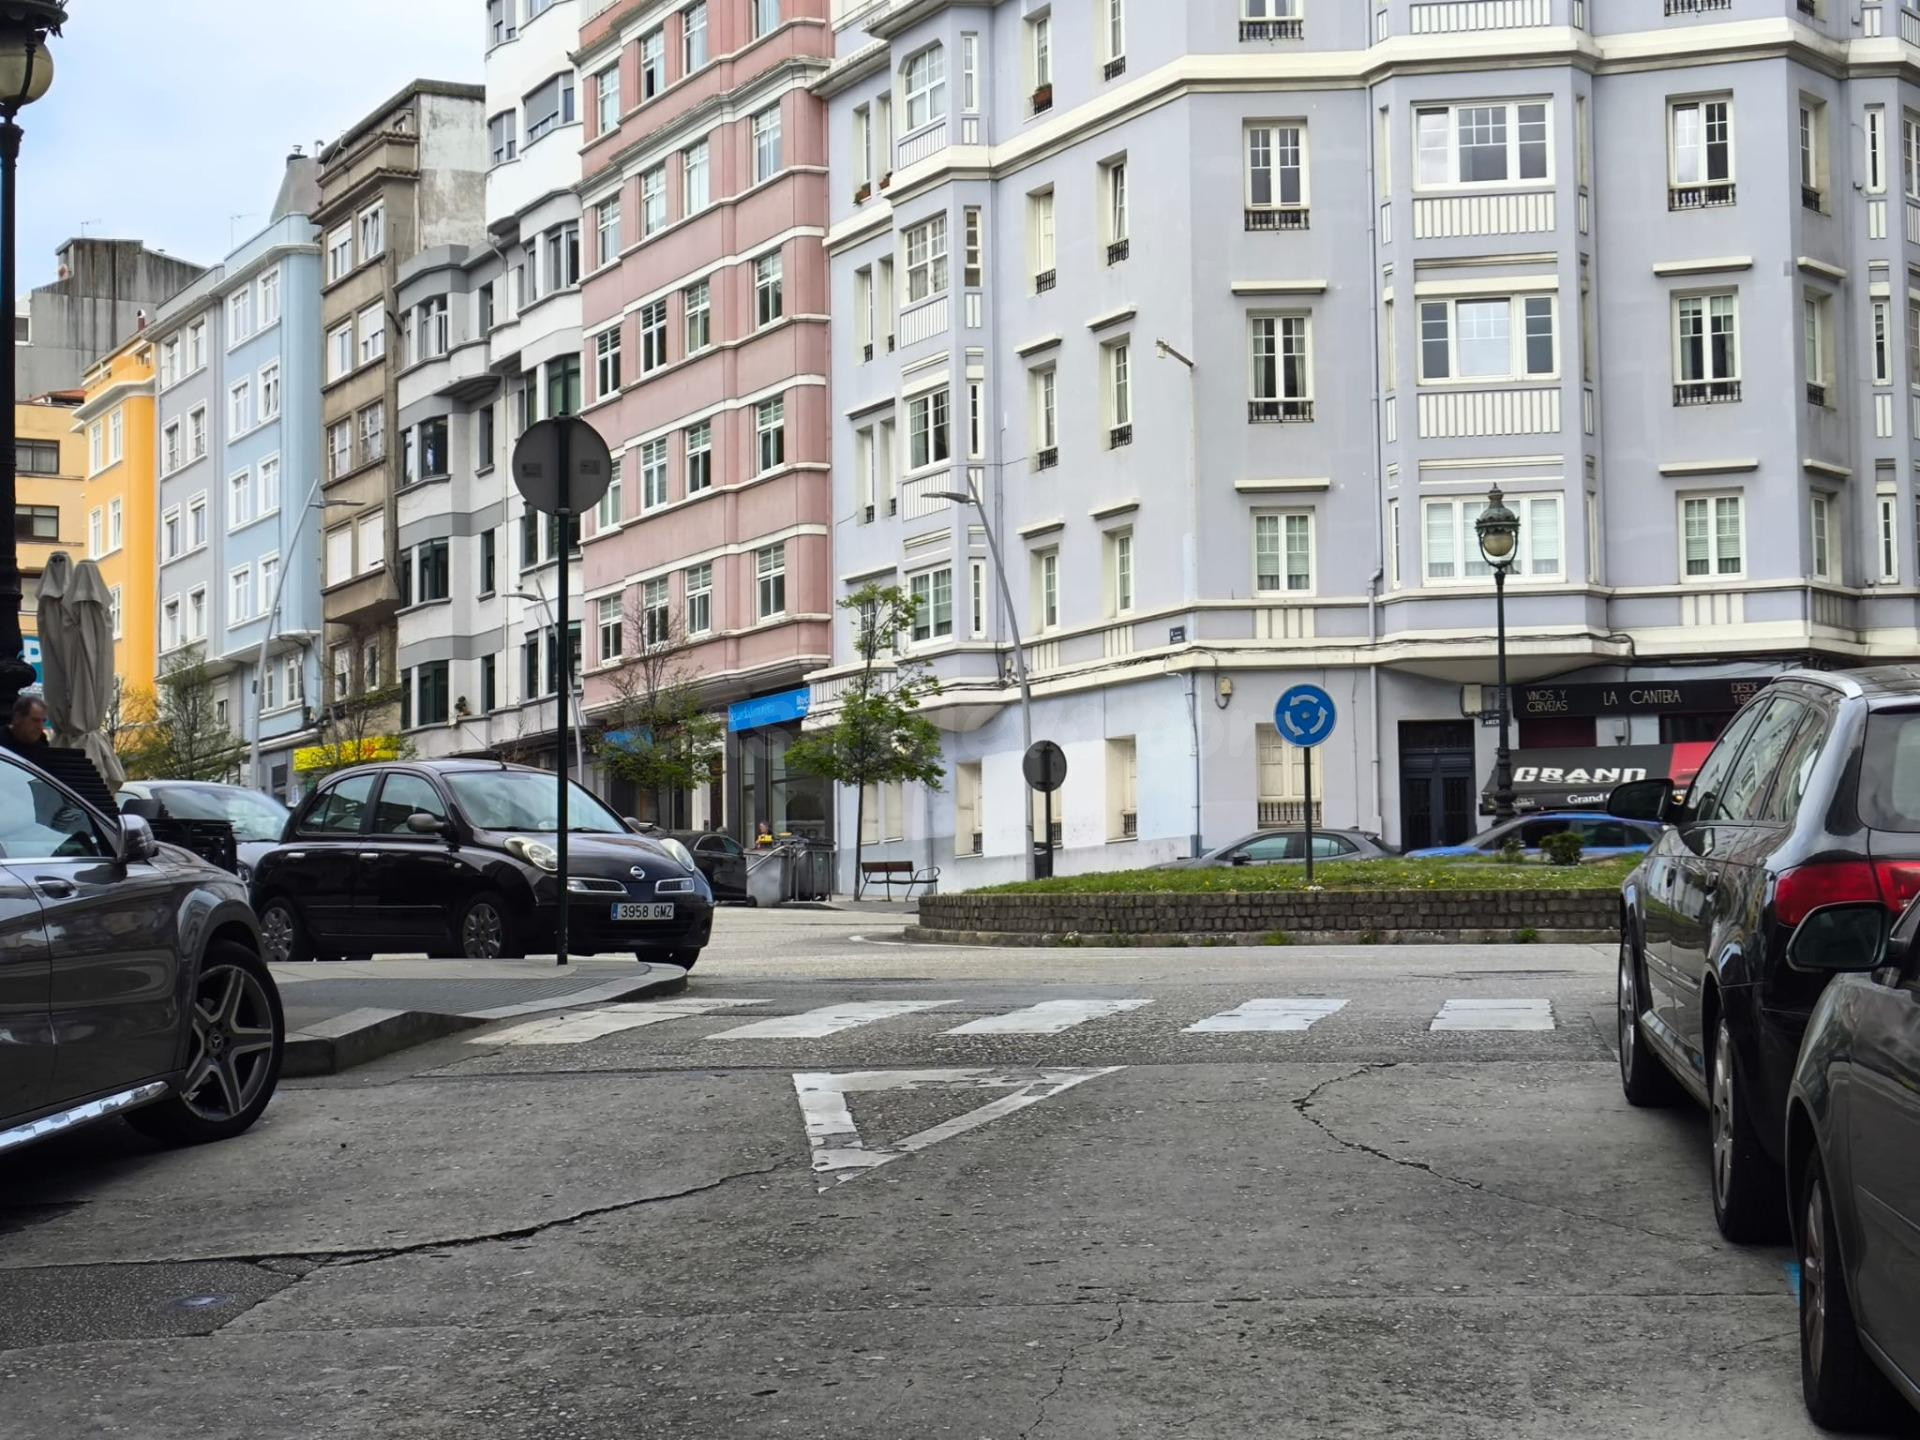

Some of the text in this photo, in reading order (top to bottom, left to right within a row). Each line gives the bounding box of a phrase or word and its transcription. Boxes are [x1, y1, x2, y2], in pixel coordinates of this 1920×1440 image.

[1560, 690, 1567, 699] Y
[1603, 690, 1681, 705] LA CANTERA
[1567, 793, 1604, 805] Grand
[621, 905, 673, 918] 3958 GMZ
